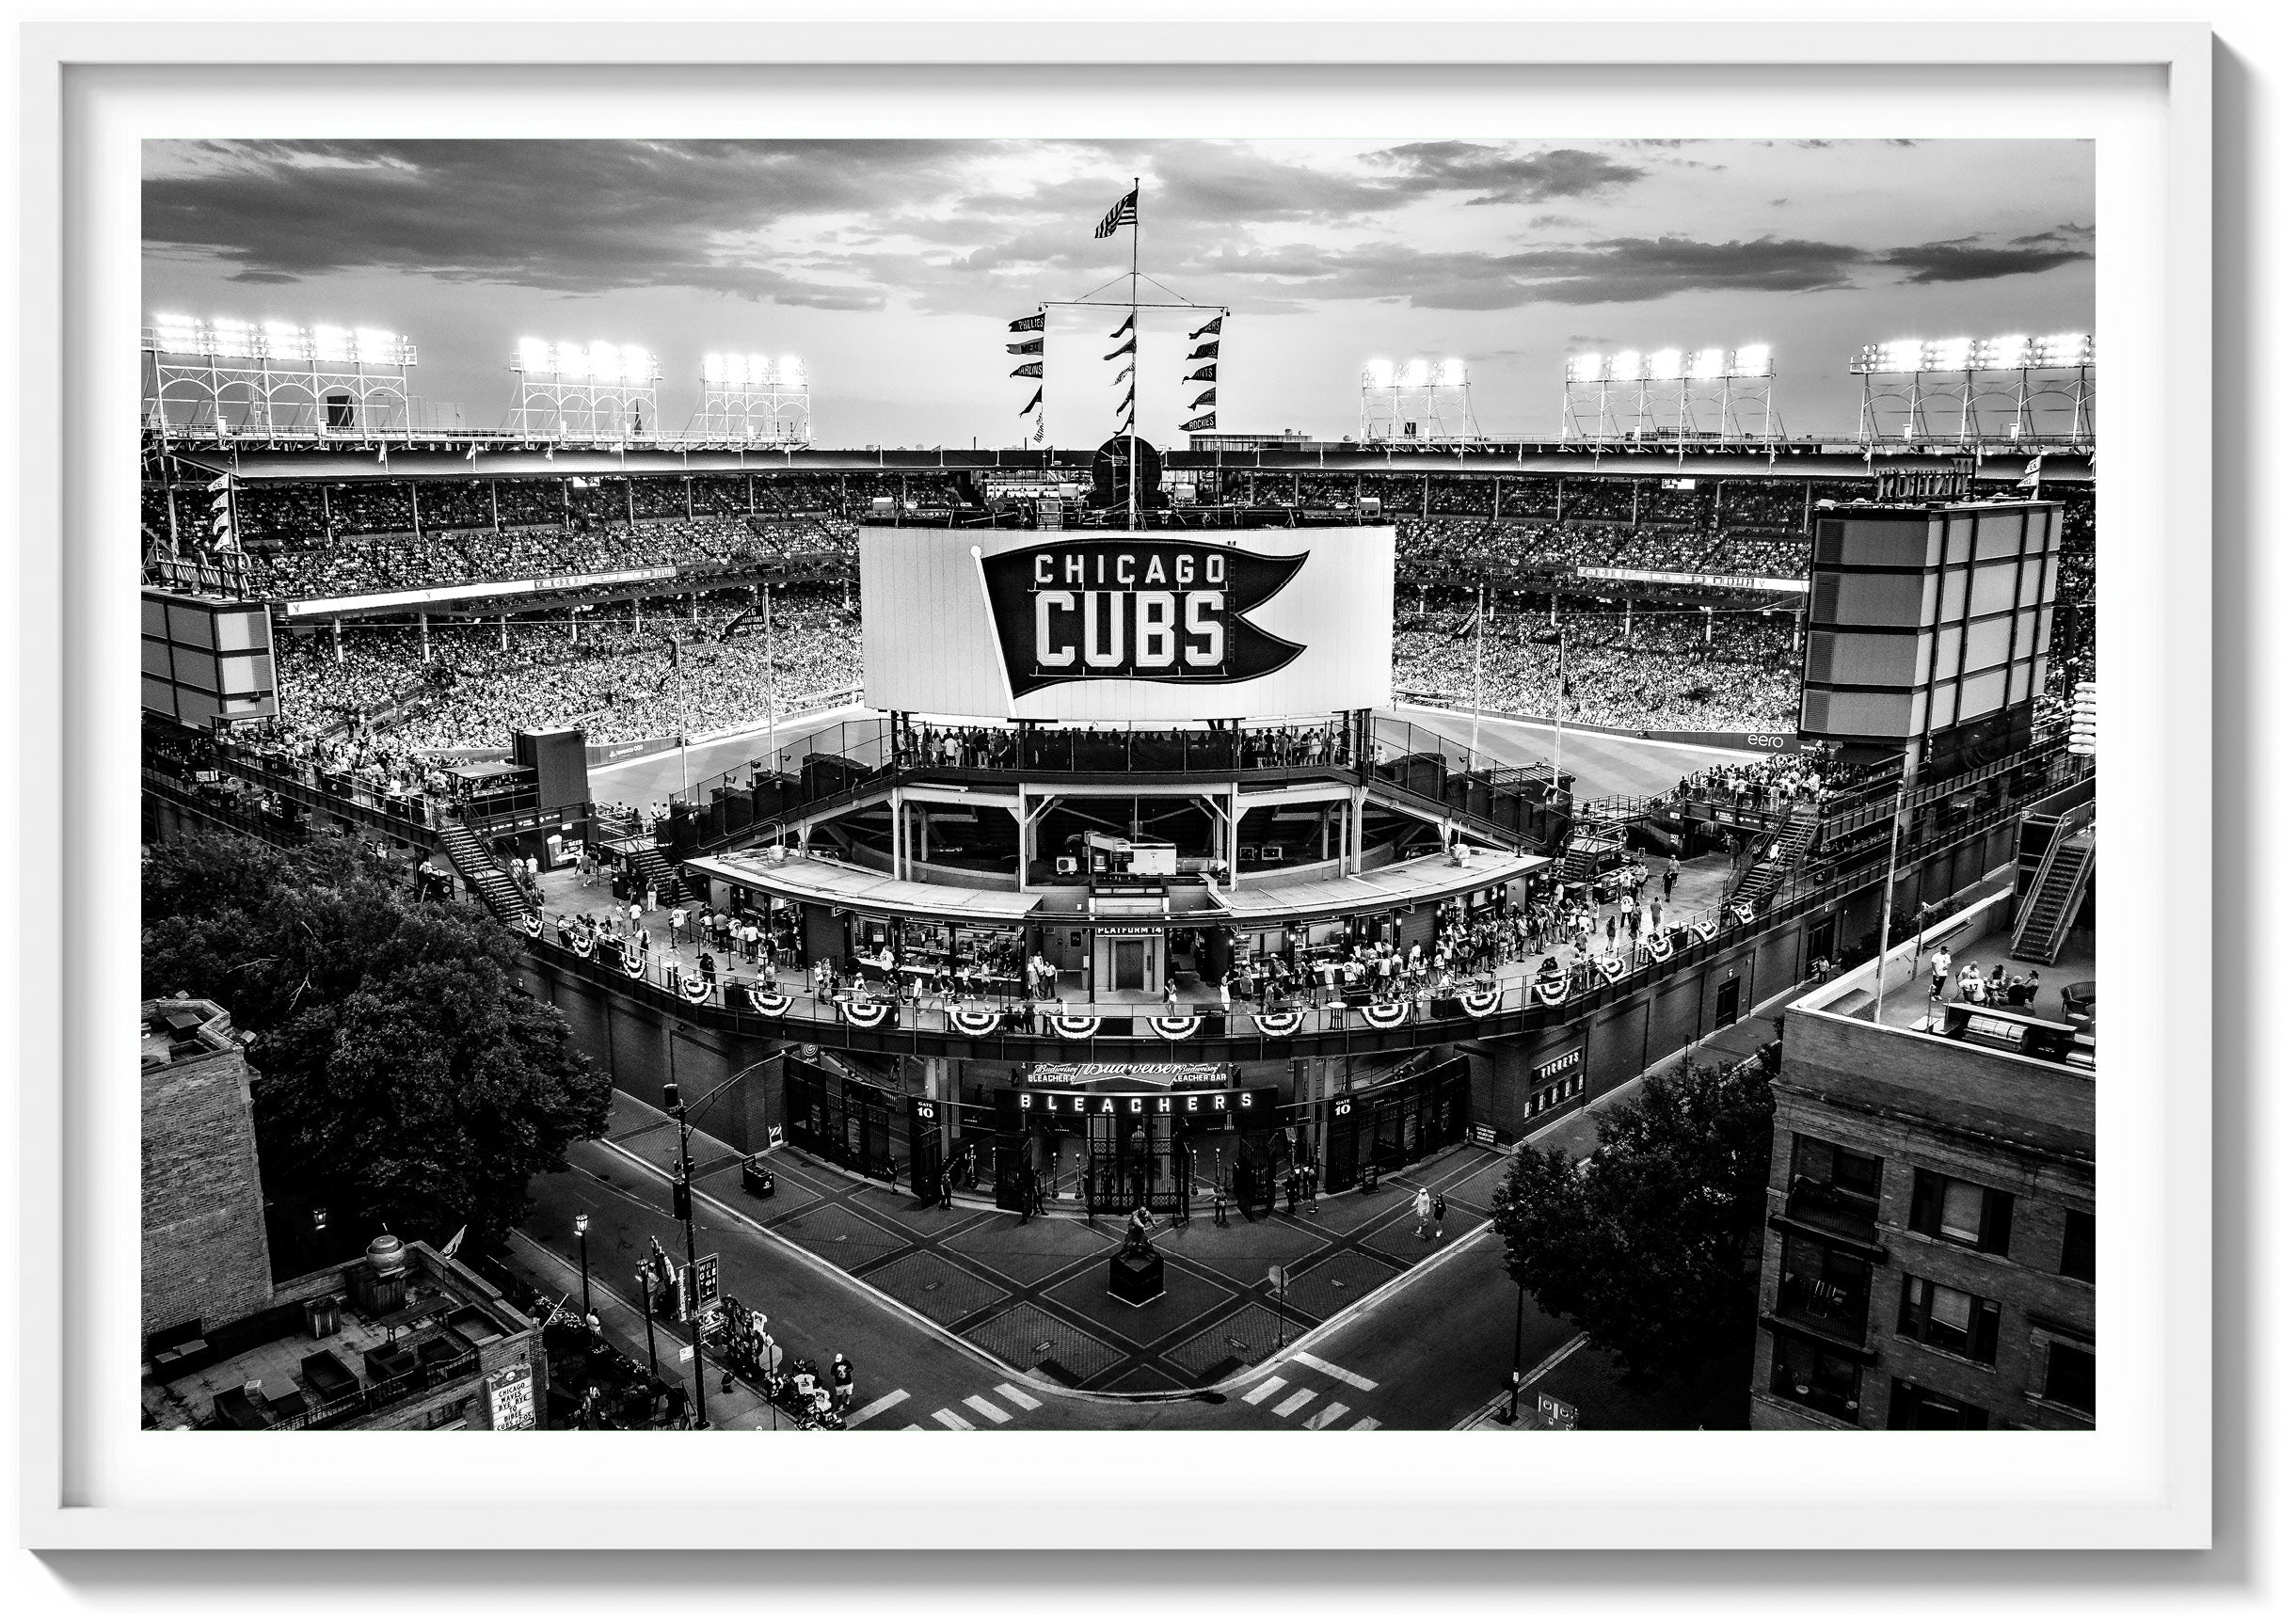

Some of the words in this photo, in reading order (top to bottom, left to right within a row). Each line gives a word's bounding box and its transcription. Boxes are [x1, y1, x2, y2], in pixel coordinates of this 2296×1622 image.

[1034, 554, 1225, 583] CHICAGO
[1034, 591, 1225, 668] CUBS
[1746, 733, 1784, 750] eero
[1540, 1051, 1580, 1078] TICKETS
[1020, 1093, 1252, 1114] BLEACHERS
[1334, 1105, 1351, 1116] 10
[917, 1107, 934, 1119] 10
[499, 1382, 525, 1397] CHICAGO
[501, 1391, 522, 1403] WAVES
[499, 1403, 511, 1411] BYE
[515, 1394, 528, 1404] BYE
[503, 1409, 522, 1423] BIBEE
[497, 1421, 514, 1430] CUBS
